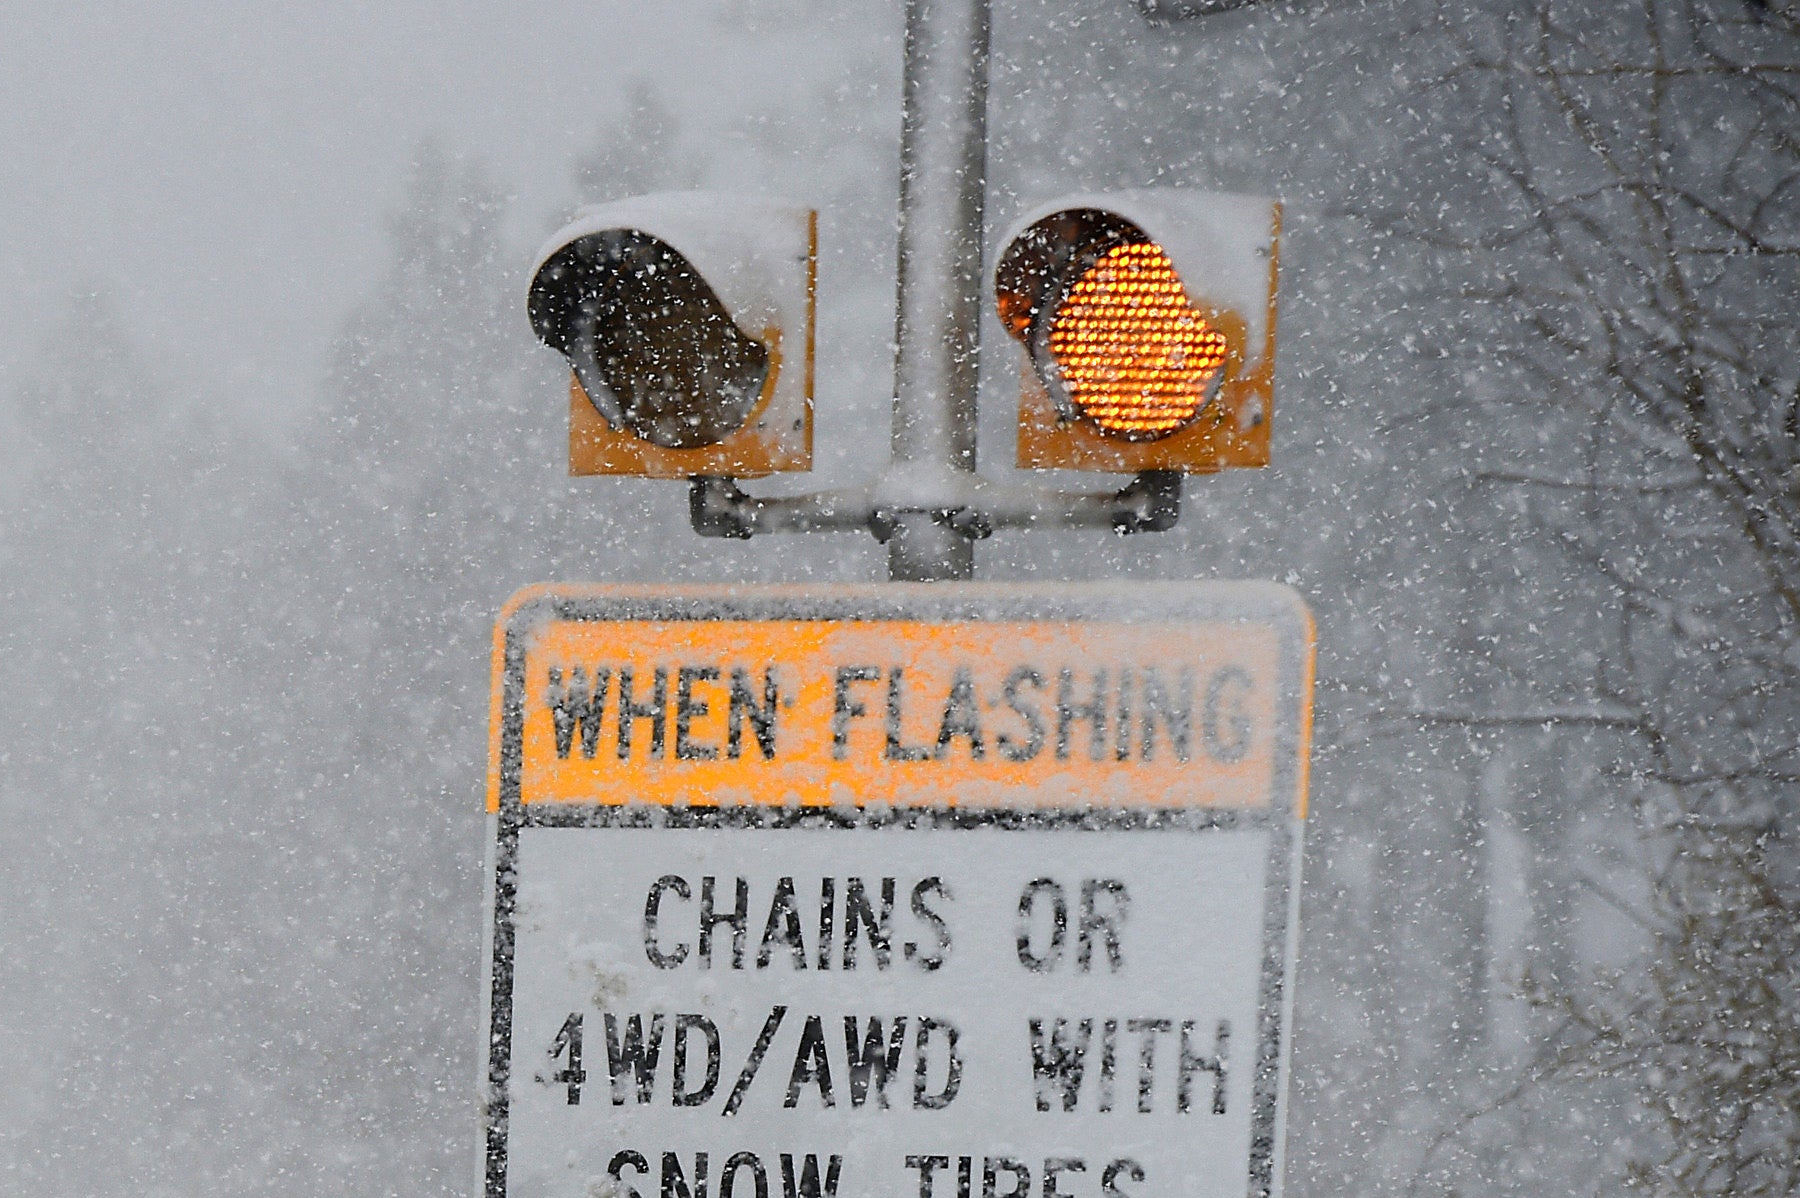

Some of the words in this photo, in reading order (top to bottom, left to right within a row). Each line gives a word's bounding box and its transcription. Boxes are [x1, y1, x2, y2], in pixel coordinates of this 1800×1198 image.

[546, 665, 780, 763] WHEN
[830, 664, 1254, 765] FLASHING
[643, 874, 954, 971] CHAINS
[1016, 877, 1132, 973] OR
[534, 1004, 962, 1116] 4WD/AWD
[1028, 1017, 1232, 1115] WITH
